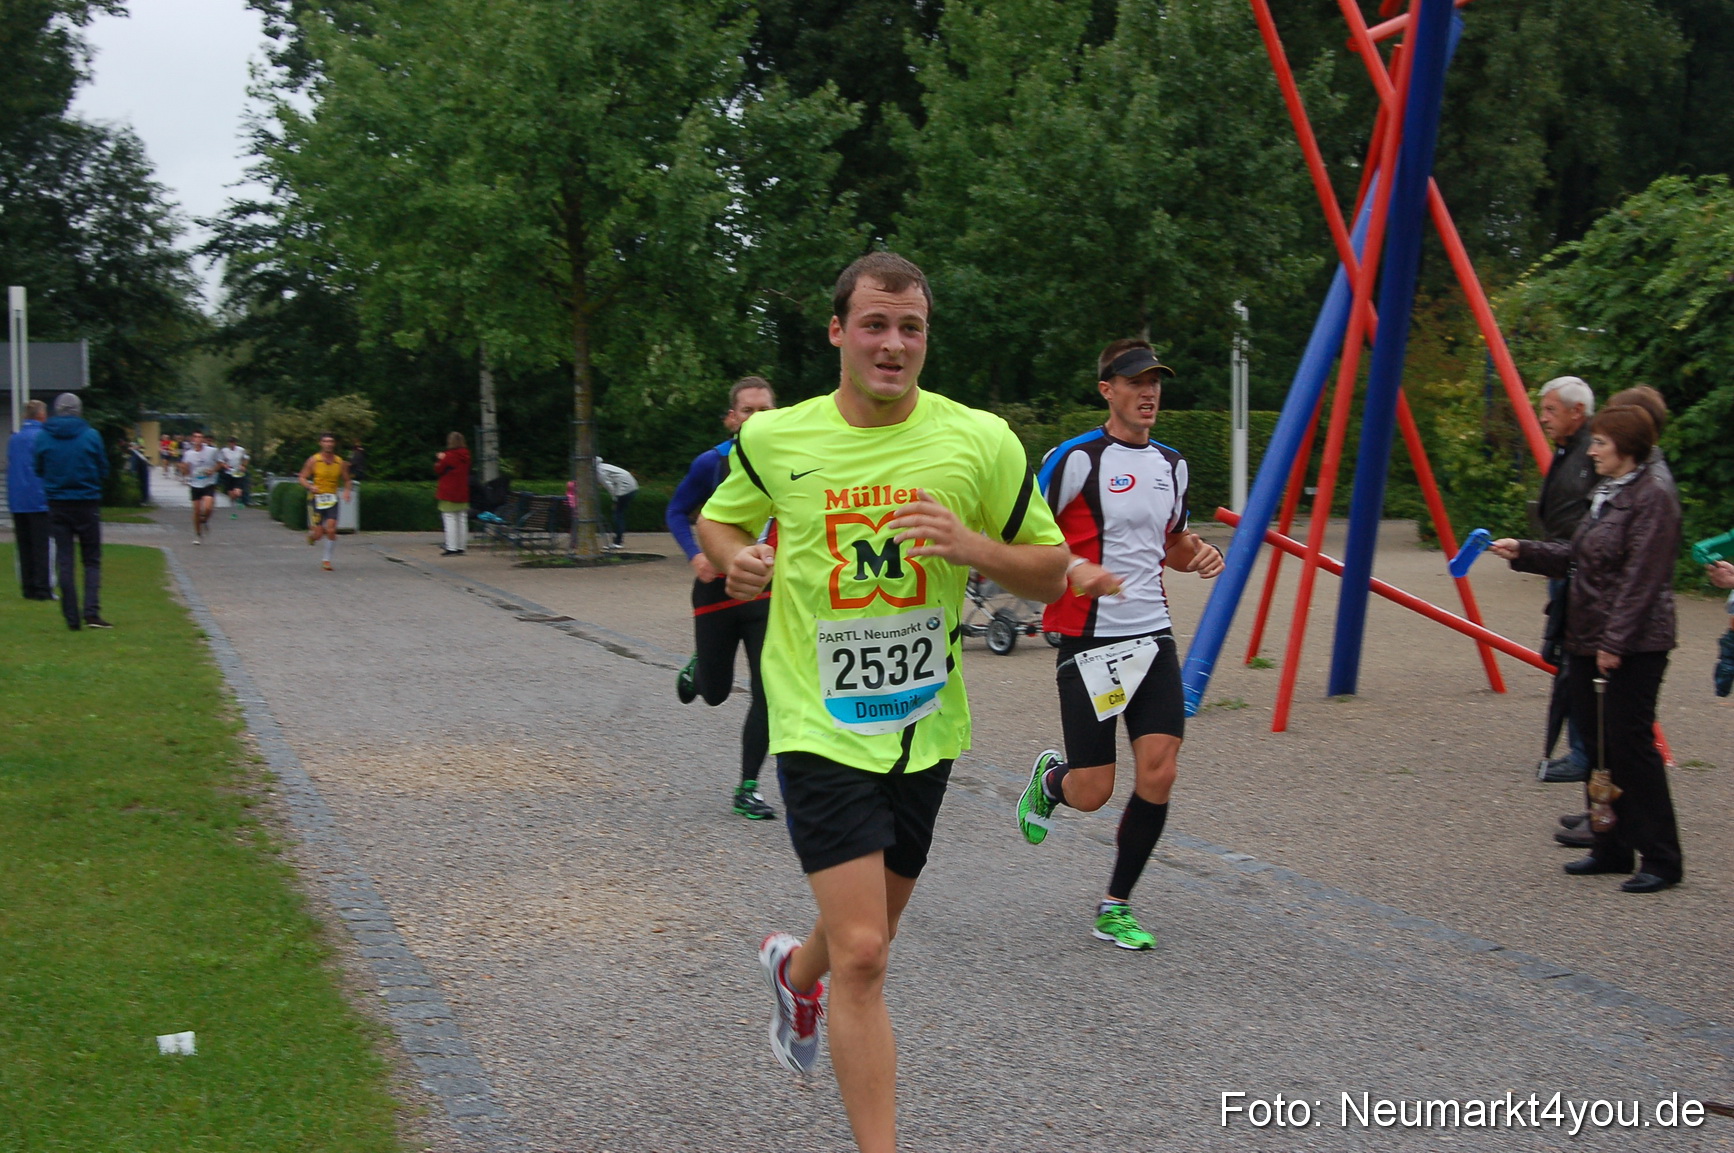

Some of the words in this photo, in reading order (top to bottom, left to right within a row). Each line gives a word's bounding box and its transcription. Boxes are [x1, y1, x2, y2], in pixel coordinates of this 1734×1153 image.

[851, 537, 905, 581] M
[818, 630, 862, 643] PARTL
[864, 622, 922, 640] Neumarkt
[832, 637, 935, 691] 2532
